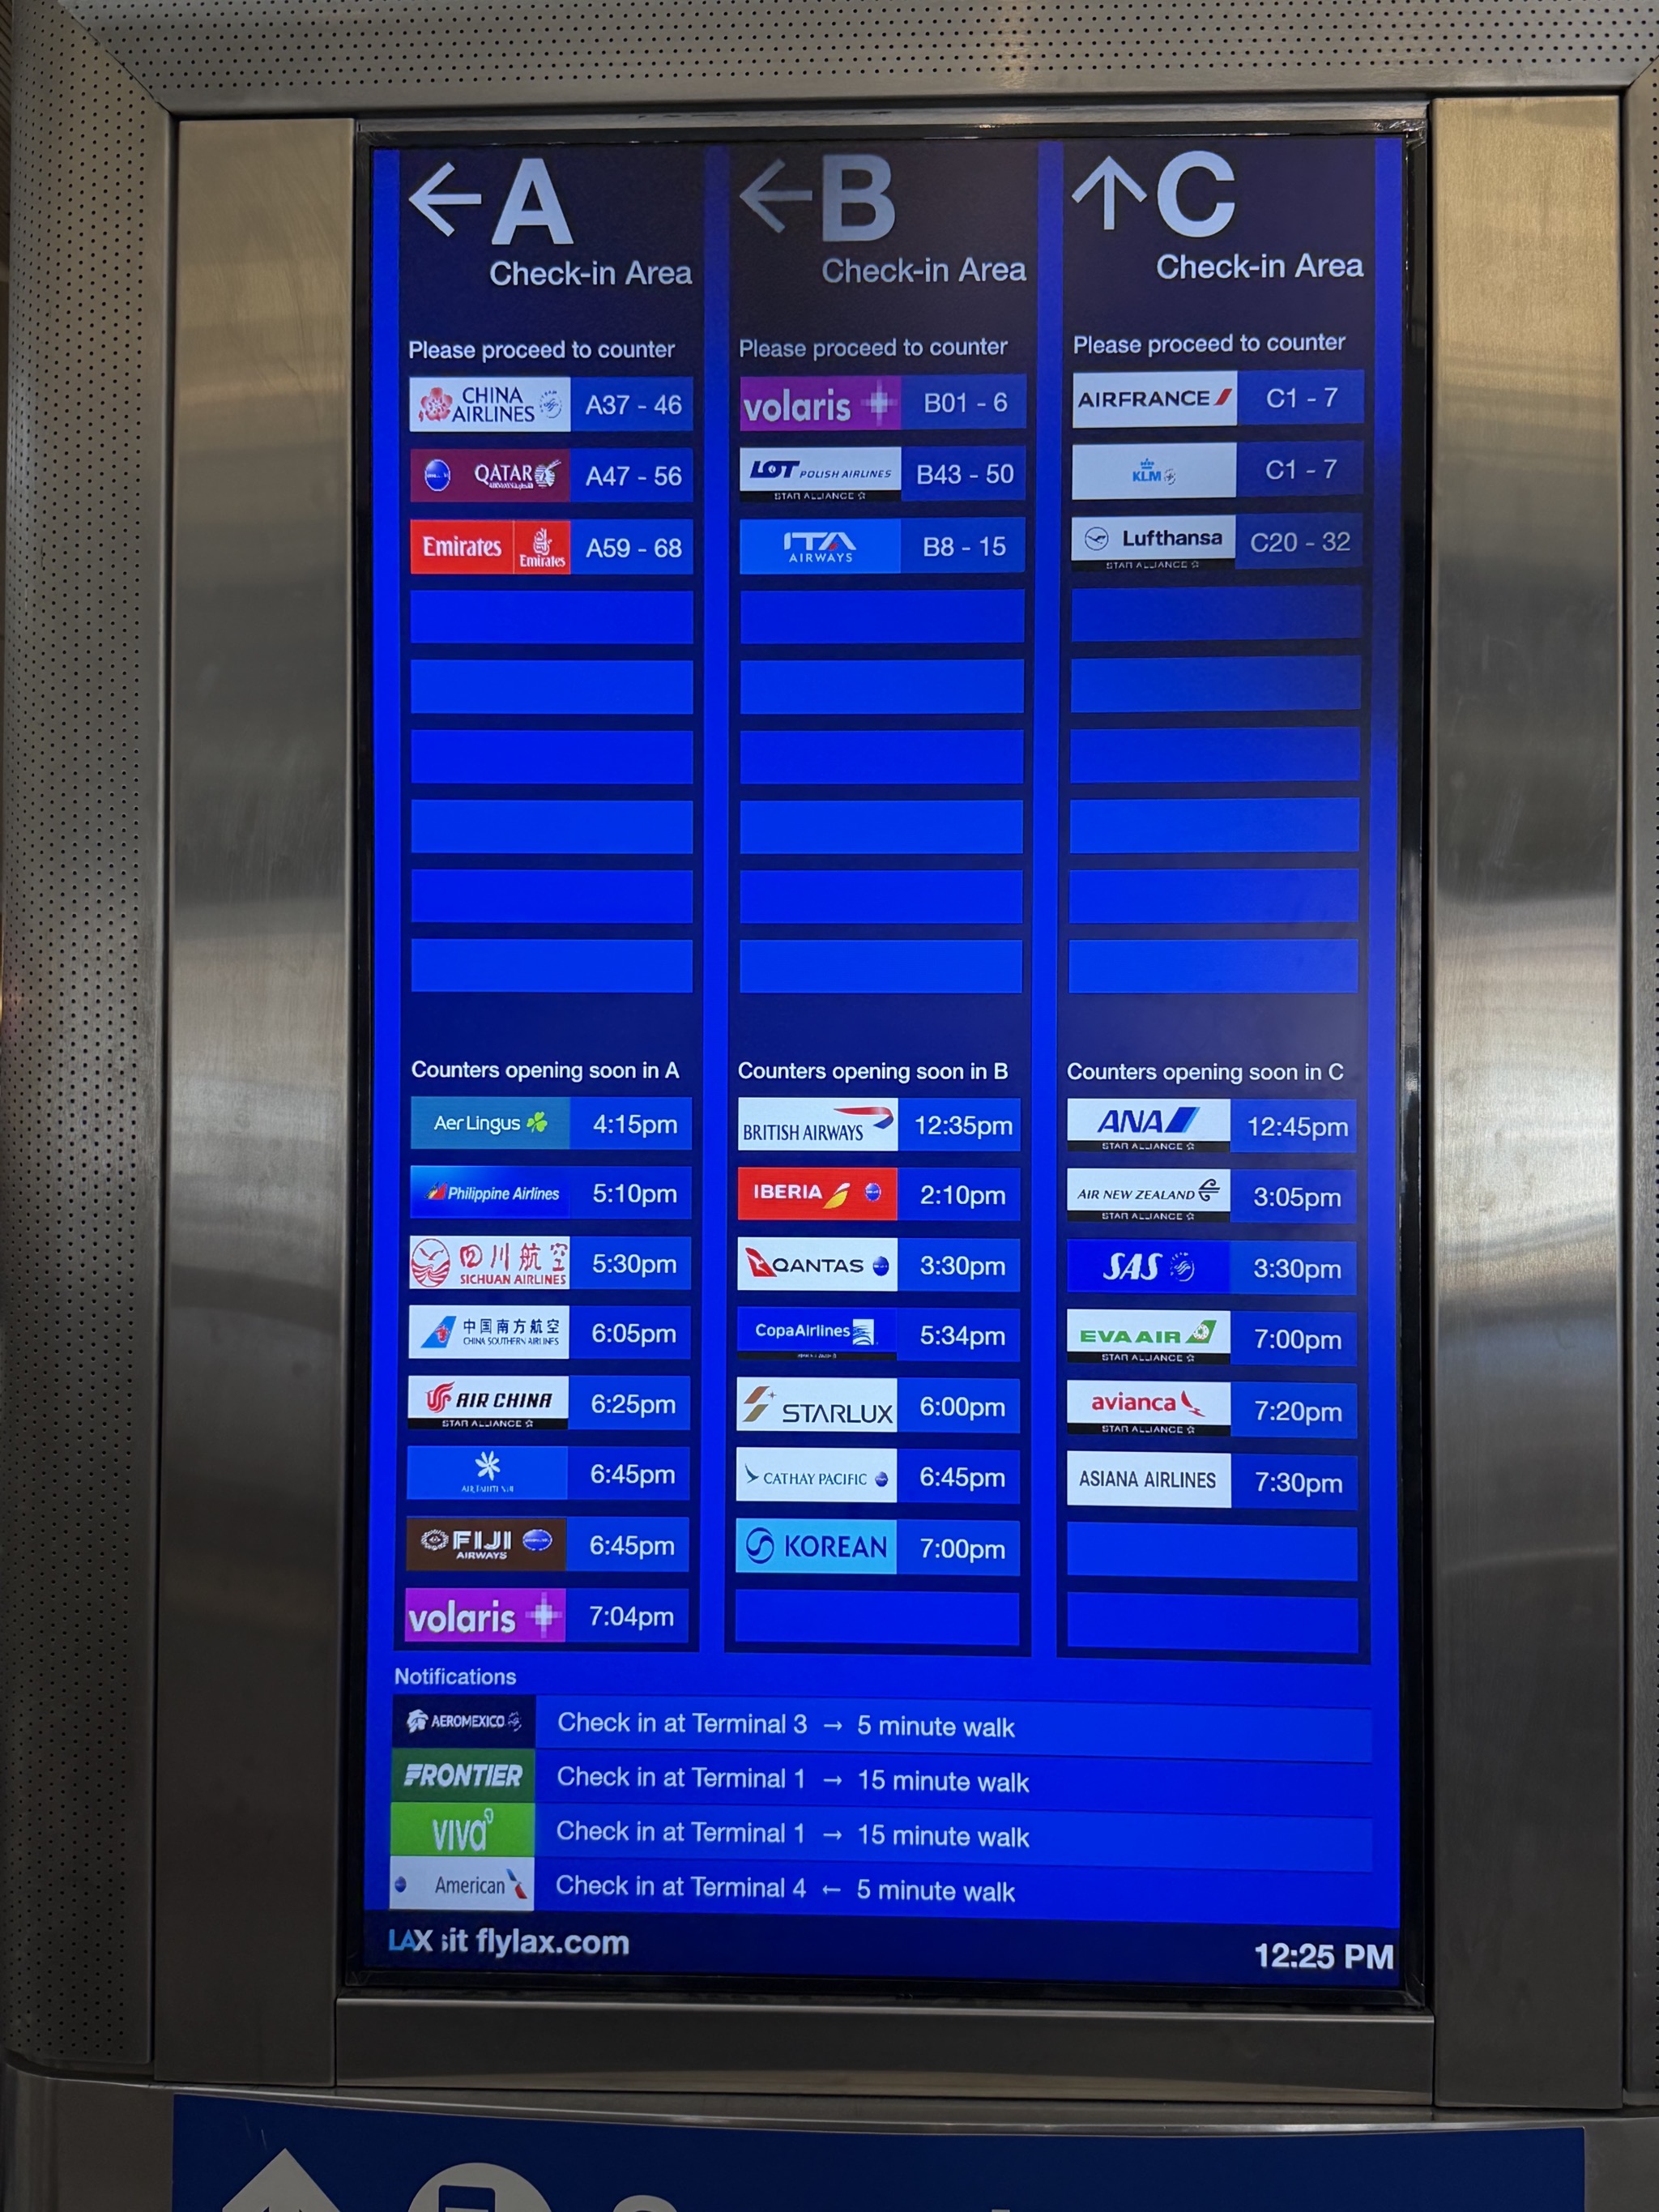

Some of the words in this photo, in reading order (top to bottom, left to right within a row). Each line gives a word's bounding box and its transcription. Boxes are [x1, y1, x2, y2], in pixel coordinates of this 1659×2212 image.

[492, 158, 574, 245] A
[823, 155, 895, 241] B
[1158, 151, 1235, 237] C
[490, 261, 615, 285] Check-in
[625, 260, 693, 284] Area
[823, 258, 948, 282] Check-in
[959, 258, 1026, 281] Area
[1158, 254, 1285, 279] Check-in
[1295, 254, 1364, 277] Area
[410, 341, 475, 358] Please
[483, 340, 565, 363] proceed
[572, 341, 591, 358] to
[598, 341, 676, 358] counter
[1074, 335, 1141, 353] Please
[1149, 334, 1233, 357] proceed
[1240, 335, 1260, 351] to
[1268, 334, 1346, 351] counter
[463, 387, 522, 404] CHINA
[586, 395, 629, 414] A37
[655, 395, 682, 414] 46
[744, 389, 851, 421] volaris
[925, 393, 965, 412] B01
[994, 392, 1007, 412] 6
[1267, 388, 1295, 408] C1
[1324, 388, 1337, 407] 7
[452, 406, 535, 422] AIRLINES
[475, 464, 532, 485] QATAR
[586, 467, 629, 485] A47
[655, 467, 681, 485] 56
[750, 461, 800, 478] LOT
[918, 465, 961, 484] B43
[987, 464, 1013, 483] 50
[1133, 472, 1161, 481] KLM
[1266, 459, 1294, 479] C1
[1324, 459, 1337, 478] 7
[424, 536, 501, 556] Emirates
[586, 538, 630, 557] A59
[655, 538, 682, 557] 68
[924, 537, 953, 556] B8
[980, 536, 1005, 556] 15
[1124, 530, 1222, 546] Lufthansa
[1251, 532, 1297, 552] C20
[1323, 532, 1350, 551] 32
[520, 554, 565, 566] Emirates
[789, 553, 852, 562] AIRWAYS
[412, 1061, 499, 1078] Counters
[505, 1061, 582, 1083] opening
[590, 1065, 636, 1078] soon
[643, 1061, 659, 1078] in
[665, 1061, 680, 1078] A
[739, 1062, 826, 1078] Counters
[833, 1062, 910, 1083] opening
[917, 1067, 963, 1079] soon
[971, 1062, 987, 1079] in
[995, 1063, 1008, 1079] B
[1068, 1063, 1157, 1079] Counters
[1163, 1063, 1242, 1084] opening
[1250, 1068, 1297, 1080] soon
[1306, 1063, 1321, 1080] in
[1329, 1063, 1343, 1080] C
[434, 1116, 464, 1129] Aer
[467, 1116, 520, 1134] Lingus
[594, 1115, 677, 1138] 4:15pm
[915, 1116, 1012, 1139] 12:35pm
[1098, 1110, 1162, 1133] ANA
[1248, 1117, 1348, 1141] 12:45pm
[744, 1125, 799, 1140] BRITISH
[803, 1125, 863, 1141] AIRWAYS
[448, 1187, 510, 1202] Philippine
[513, 1187, 559, 1200] Airlines
[594, 1184, 676, 1207] 5:10pm
[755, 1185, 822, 1198] IBERIA
[921, 1185, 1005, 1209] 2:10pm
[1077, 1189, 1099, 1199] AIR
[1103, 1190, 1132, 1199] NEW
[1135, 1190, 1195, 1199] ZEALAND
[1255, 1188, 1341, 1211] 3:05pm
[593, 1254, 676, 1278] 5:30pm
[773, 1258, 864, 1272] QANTAS
[921, 1256, 1005, 1279] 3:30pm
[1103, 1253, 1162, 1280] SAS
[1255, 1259, 1341, 1283] 3:30pm
[461, 1275, 510, 1284] SICHUAN
[514, 1275, 565, 1284] AIRLINES
[463, 1318, 560, 1334] 中国南方航空
[593, 1324, 676, 1347] 6:05pm
[921, 1326, 1004, 1349] 5:34pm
[1256, 1329, 1341, 1353] 7:00pm
[456, 1394, 489, 1407] AIR
[493, 1394, 552, 1407] CHINA
[592, 1394, 675, 1418] 6:25pm
[921, 1397, 1004, 1420] 6:00pm
[1092, 1392, 1175, 1411] avianca
[783, 1404, 893, 1423] STARLUX
[1256, 1401, 1341, 1425] 7:20pm
[591, 1464, 675, 1488] 6:45pm
[764, 1473, 815, 1484] CATHAY
[819, 1473, 867, 1485] PACIFIC
[920, 1467, 1004, 1491] 6:45pm
[1080, 1471, 1138, 1487] ASIANA
[1145, 1471, 1215, 1488] AIRLINES
[1256, 1472, 1342, 1497] 7:30pm
[454, 1531, 511, 1549] FIJI
[591, 1535, 674, 1560] 6:45pm
[786, 1535, 886, 1557] KOREAN
[921, 1539, 1004, 1563] 7:00pm
[408, 1600, 517, 1633] volaris
[591, 1606, 673, 1630] 7:04pm
[395, 1668, 516, 1685] Notifications
[432, 1715, 505, 1727] AEROMEXICO
[559, 1712, 630, 1732] Check
[638, 1712, 655, 1732] in
[664, 1714, 685, 1732] at
[693, 1713, 785, 1733] Terminal
[794, 1715, 807, 1733] 3
[858, 1715, 871, 1734] 5
[880, 1716, 956, 1736] minute
[963, 1718, 1015, 1737] walk
[404, 1763, 522, 1787] FRONTIER
[558, 1766, 629, 1786] Check
[638, 1766, 655, 1787] in
[664, 1768, 684, 1787] at
[692, 1767, 785, 1787] Terminal
[795, 1769, 803, 1788] 1
[859, 1770, 885, 1789] 15
[894, 1770, 970, 1791] minute
[978, 1773, 1030, 1792] walk
[435, 1877, 505, 1894] American
[557, 1875, 629, 1894] Check
[637, 1876, 654, 1895] in
[663, 1877, 684, 1895] at
[691, 1877, 784, 1898] Terminal
[793, 1878, 806, 1898] 4
[858, 1879, 870, 1898] 5
[879, 1880, 956, 1900] minute
[963, 1882, 1015, 1902] walk
[390, 1929, 433, 1951] LAX
[476, 1928, 629, 1958] flylax.com
[1256, 1943, 1334, 1969] 12:25
[1346, 1944, 1393, 1969] PM
